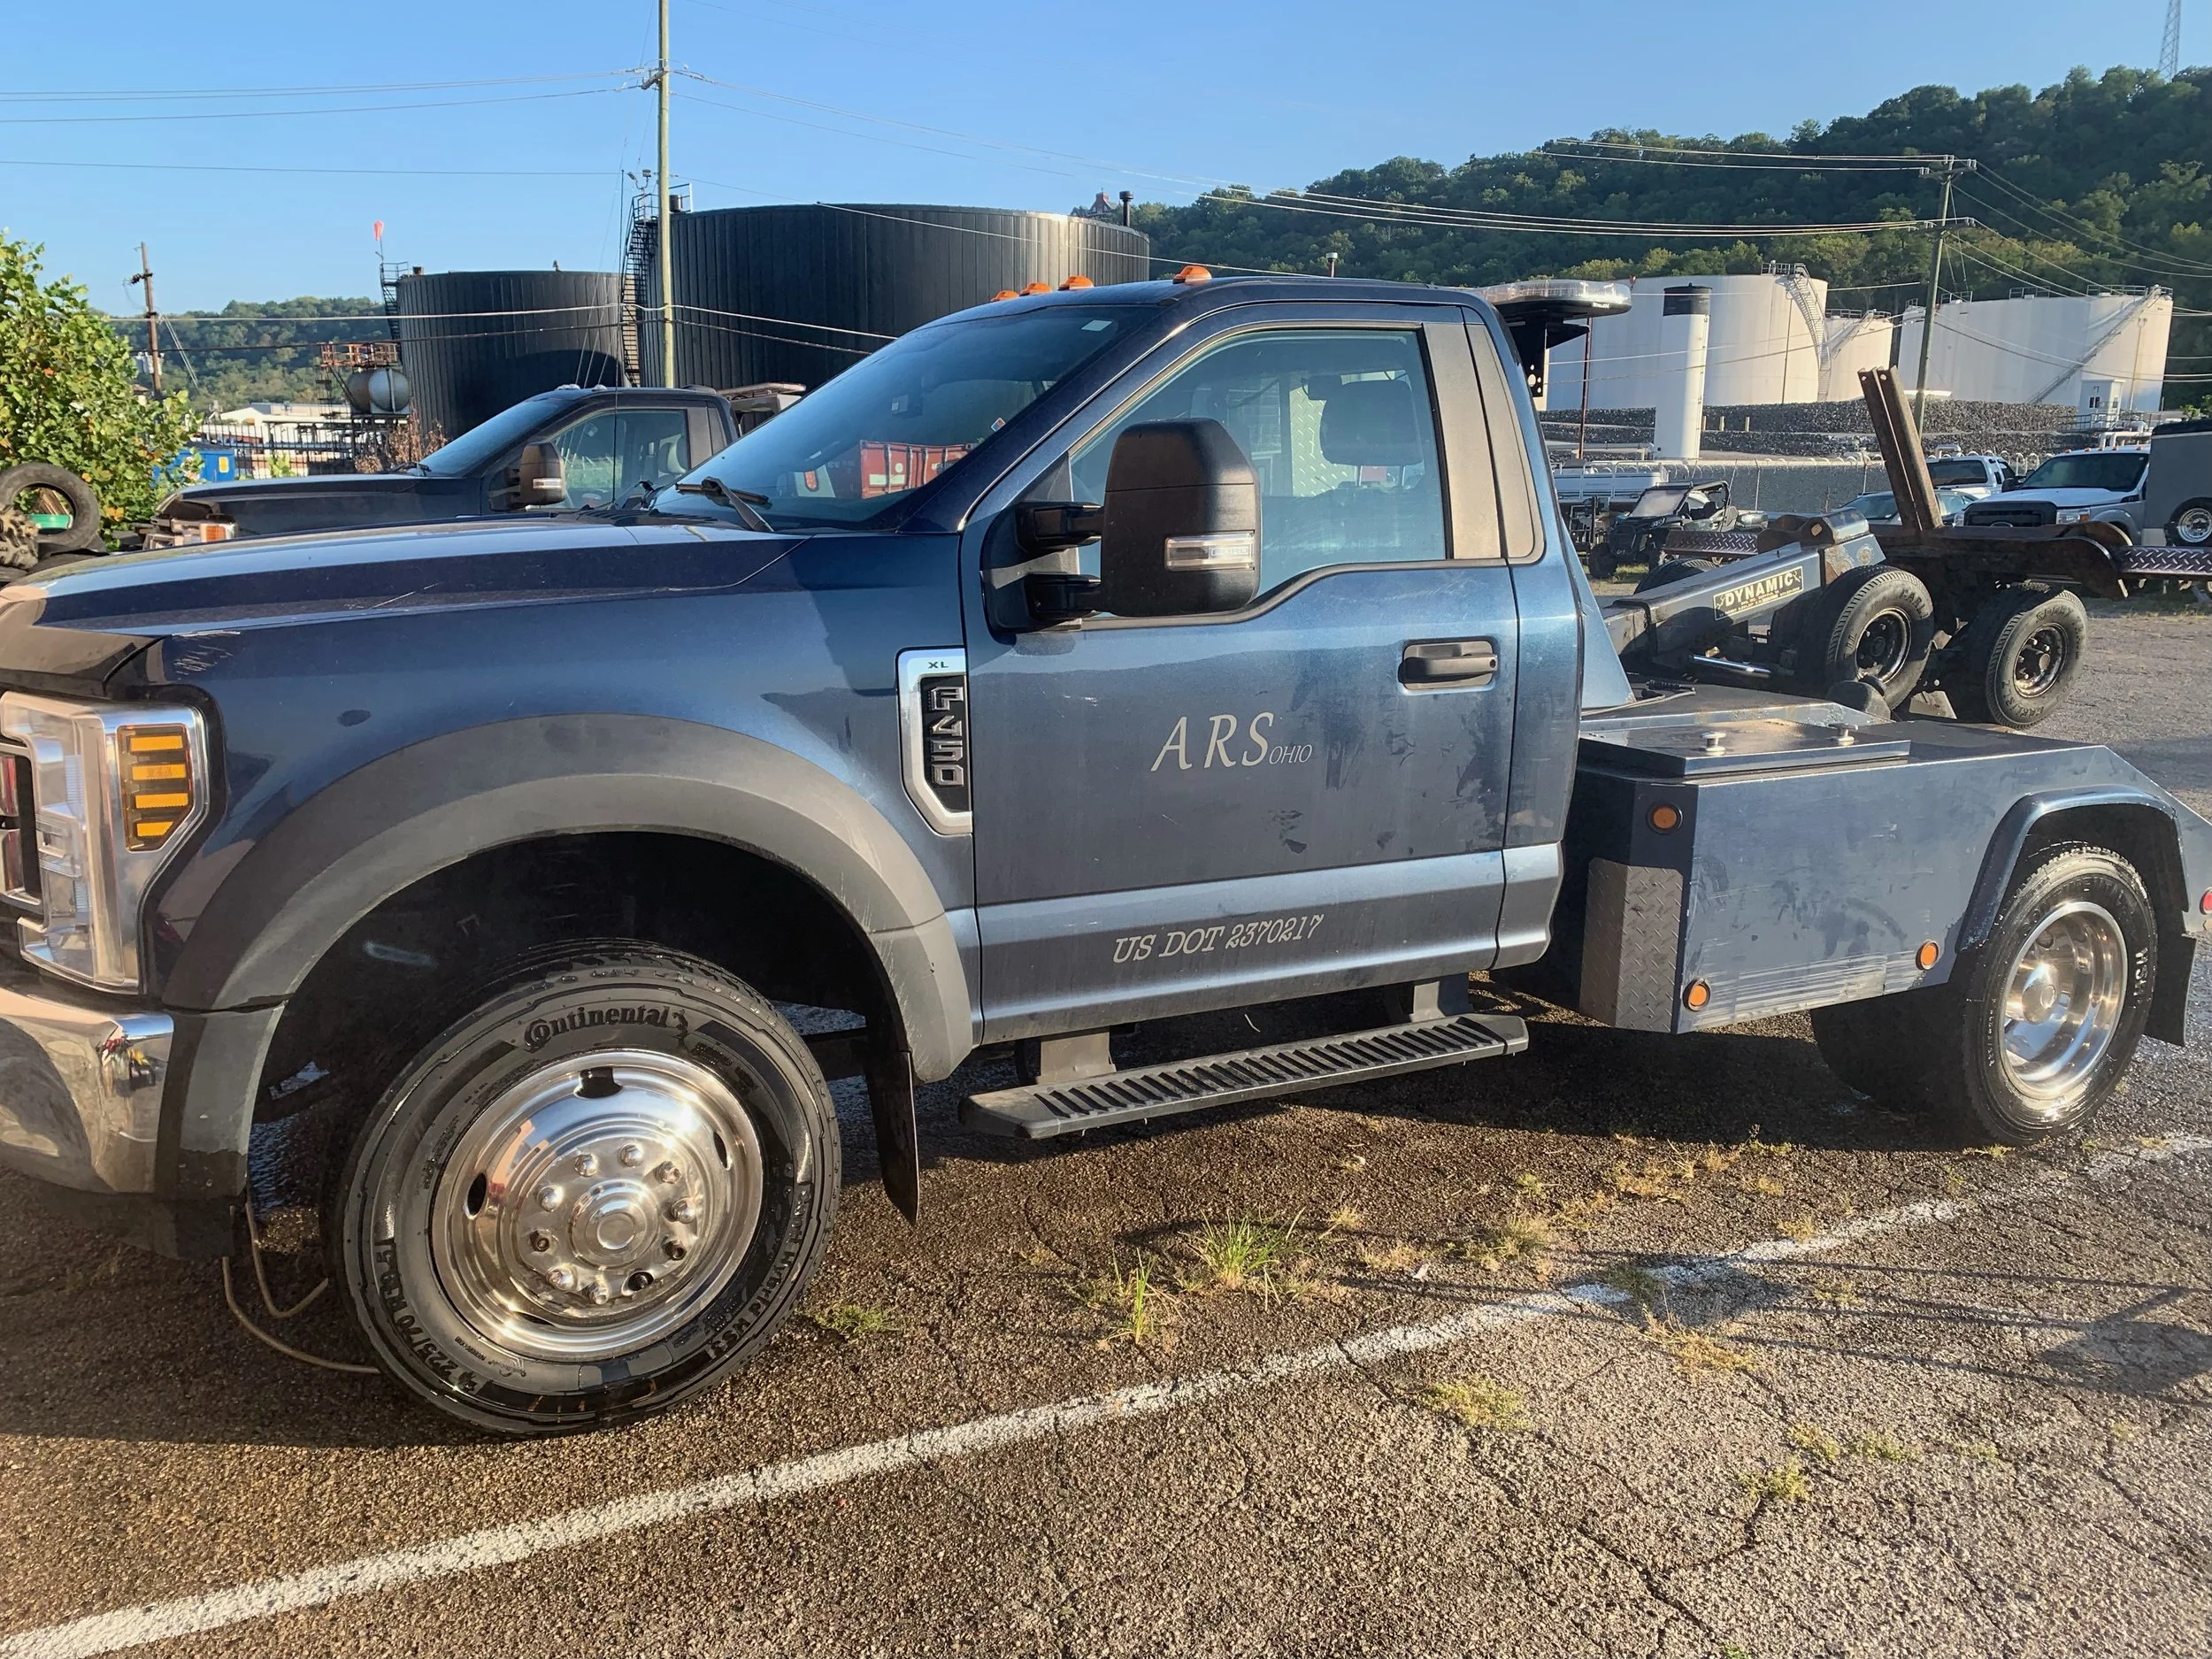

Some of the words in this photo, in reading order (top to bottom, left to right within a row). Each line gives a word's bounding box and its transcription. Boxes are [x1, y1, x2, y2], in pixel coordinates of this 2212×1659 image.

[1724, 572, 1793, 607] DYNAMIC
[1269, 744, 1313, 764] OHIO
[1112, 933, 1156, 964] US
[1158, 926, 1226, 957] DOT
[1225, 913, 1325, 950] 2370217
[523, 1004, 669, 1053] Continental
[749, 1251, 795, 1317] Hybrid
[396, 1315, 459, 1383] 225/70
